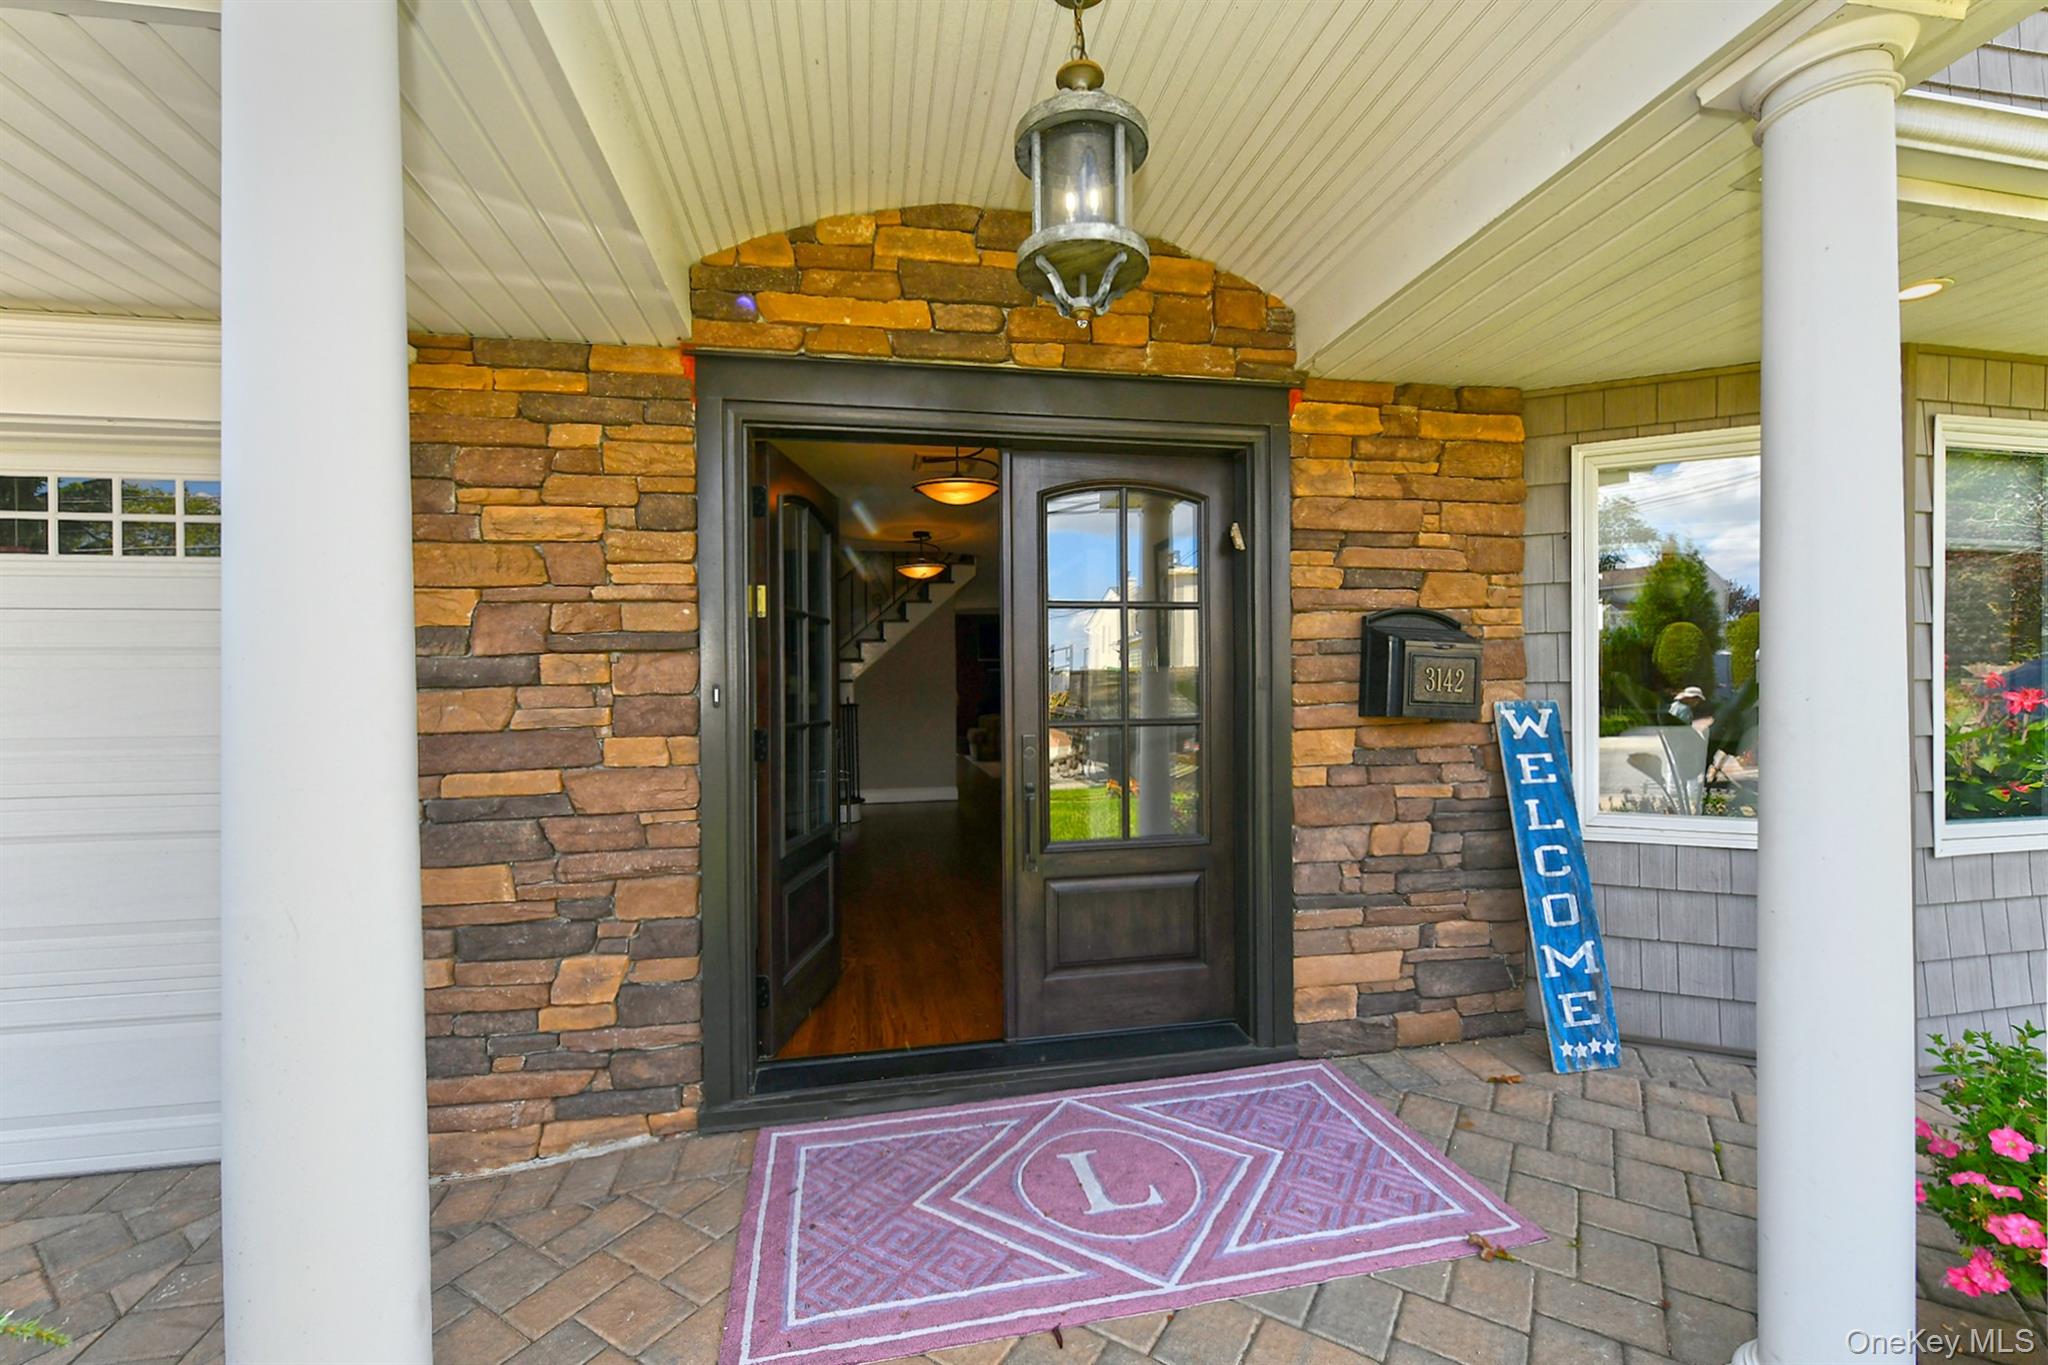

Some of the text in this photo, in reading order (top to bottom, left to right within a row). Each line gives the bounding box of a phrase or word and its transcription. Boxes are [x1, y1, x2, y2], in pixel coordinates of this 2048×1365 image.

[1425, 666, 1465, 693] 3142
[1499, 708, 1601, 1028] WELCOME
[1056, 1148, 1164, 1215] L
